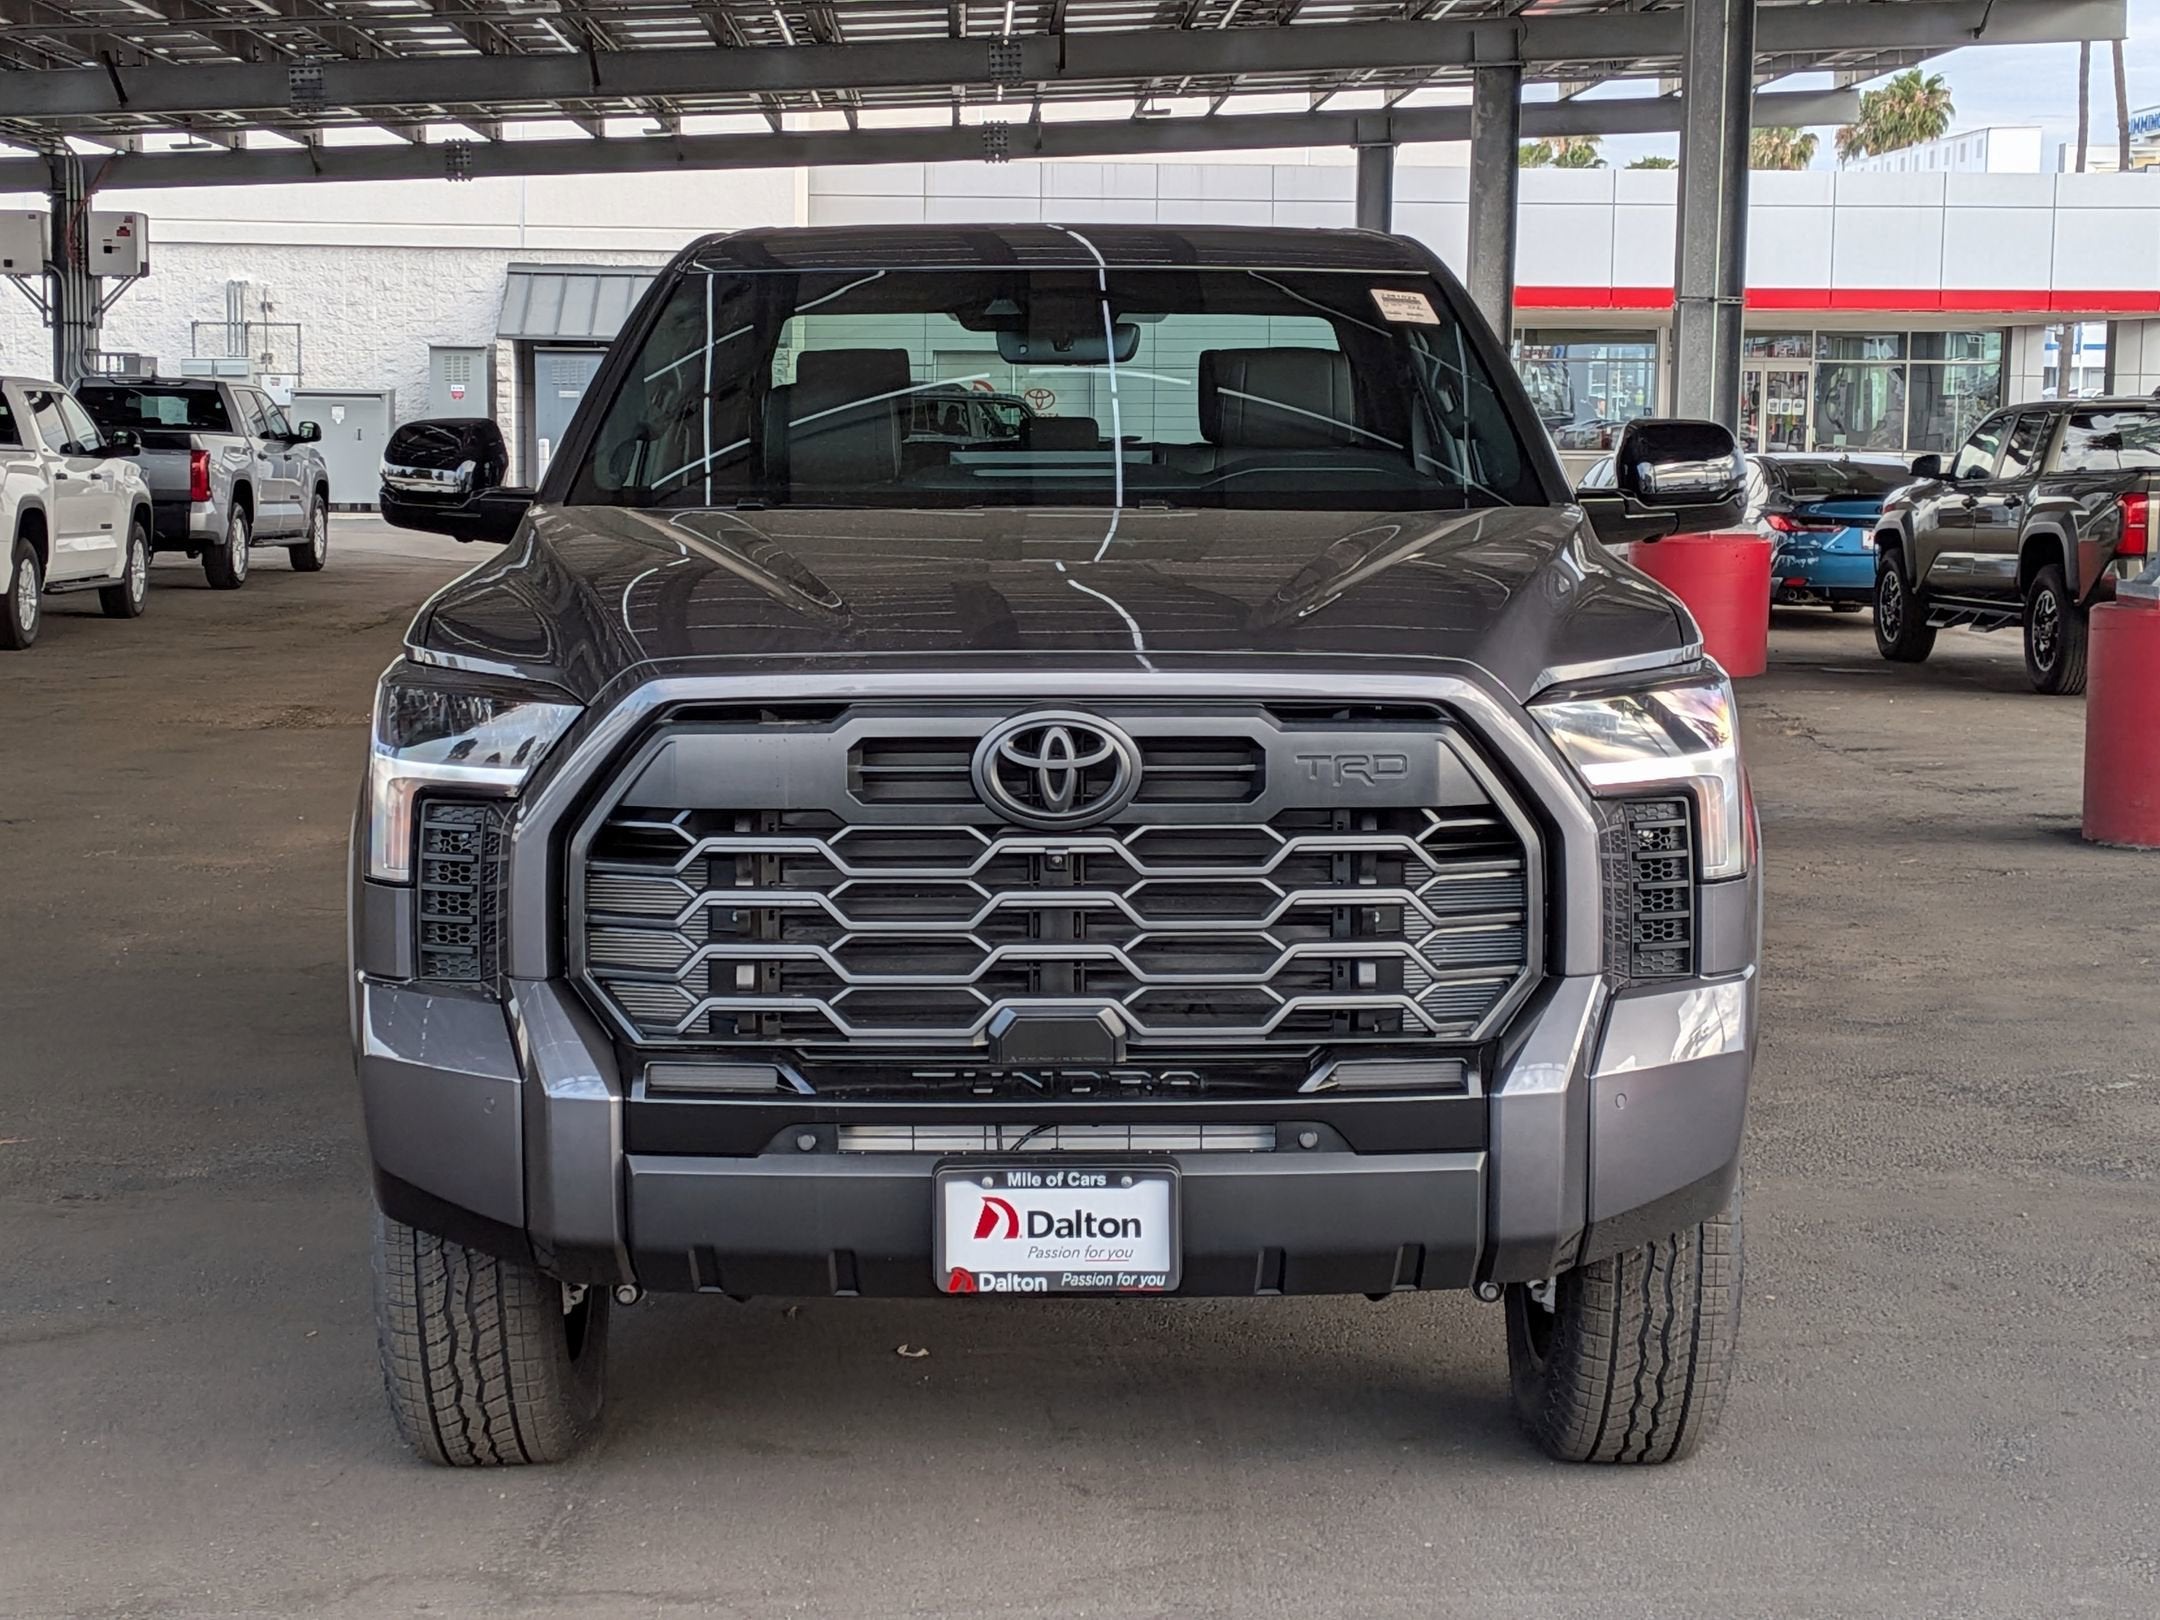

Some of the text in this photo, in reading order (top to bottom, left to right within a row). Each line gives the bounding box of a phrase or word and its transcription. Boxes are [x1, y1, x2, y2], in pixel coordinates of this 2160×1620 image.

[1295, 754, 1408, 787] TRD
[1007, 1172, 1107, 1187] Mile of Cars
[1027, 1209, 1142, 1239] Dalton
[1027, 1244, 1134, 1261] Passion for you
[978, 1272, 1048, 1292] Dalton
[1060, 1271, 1166, 1289] Passion for you
